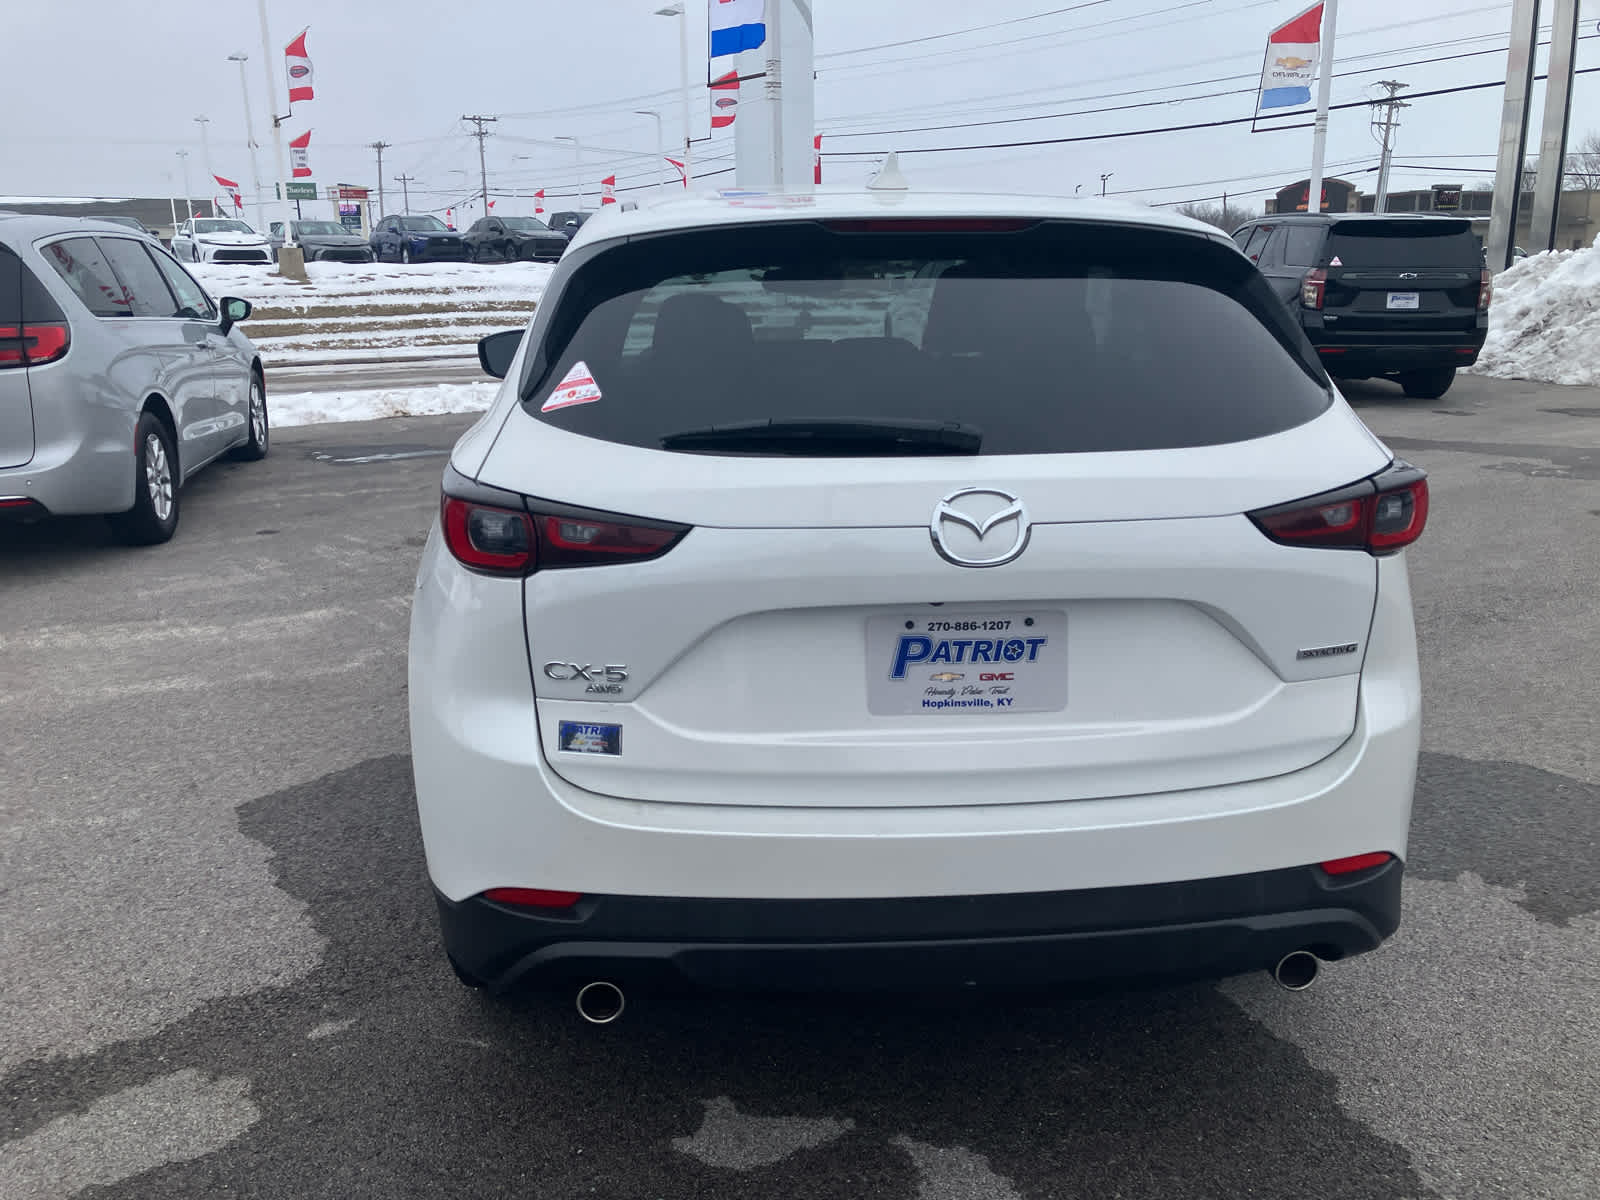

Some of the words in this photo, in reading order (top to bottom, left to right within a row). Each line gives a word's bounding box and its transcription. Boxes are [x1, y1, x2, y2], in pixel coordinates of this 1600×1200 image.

[927, 620, 1012, 632] 270-886-1207
[889, 635, 1048, 680] PATRIOT
[543, 661, 629, 682] CX-5
[979, 672, 1014, 681] GMC
[922, 699, 994, 709] Hopkinsville,
[997, 697, 1013, 706] KY
